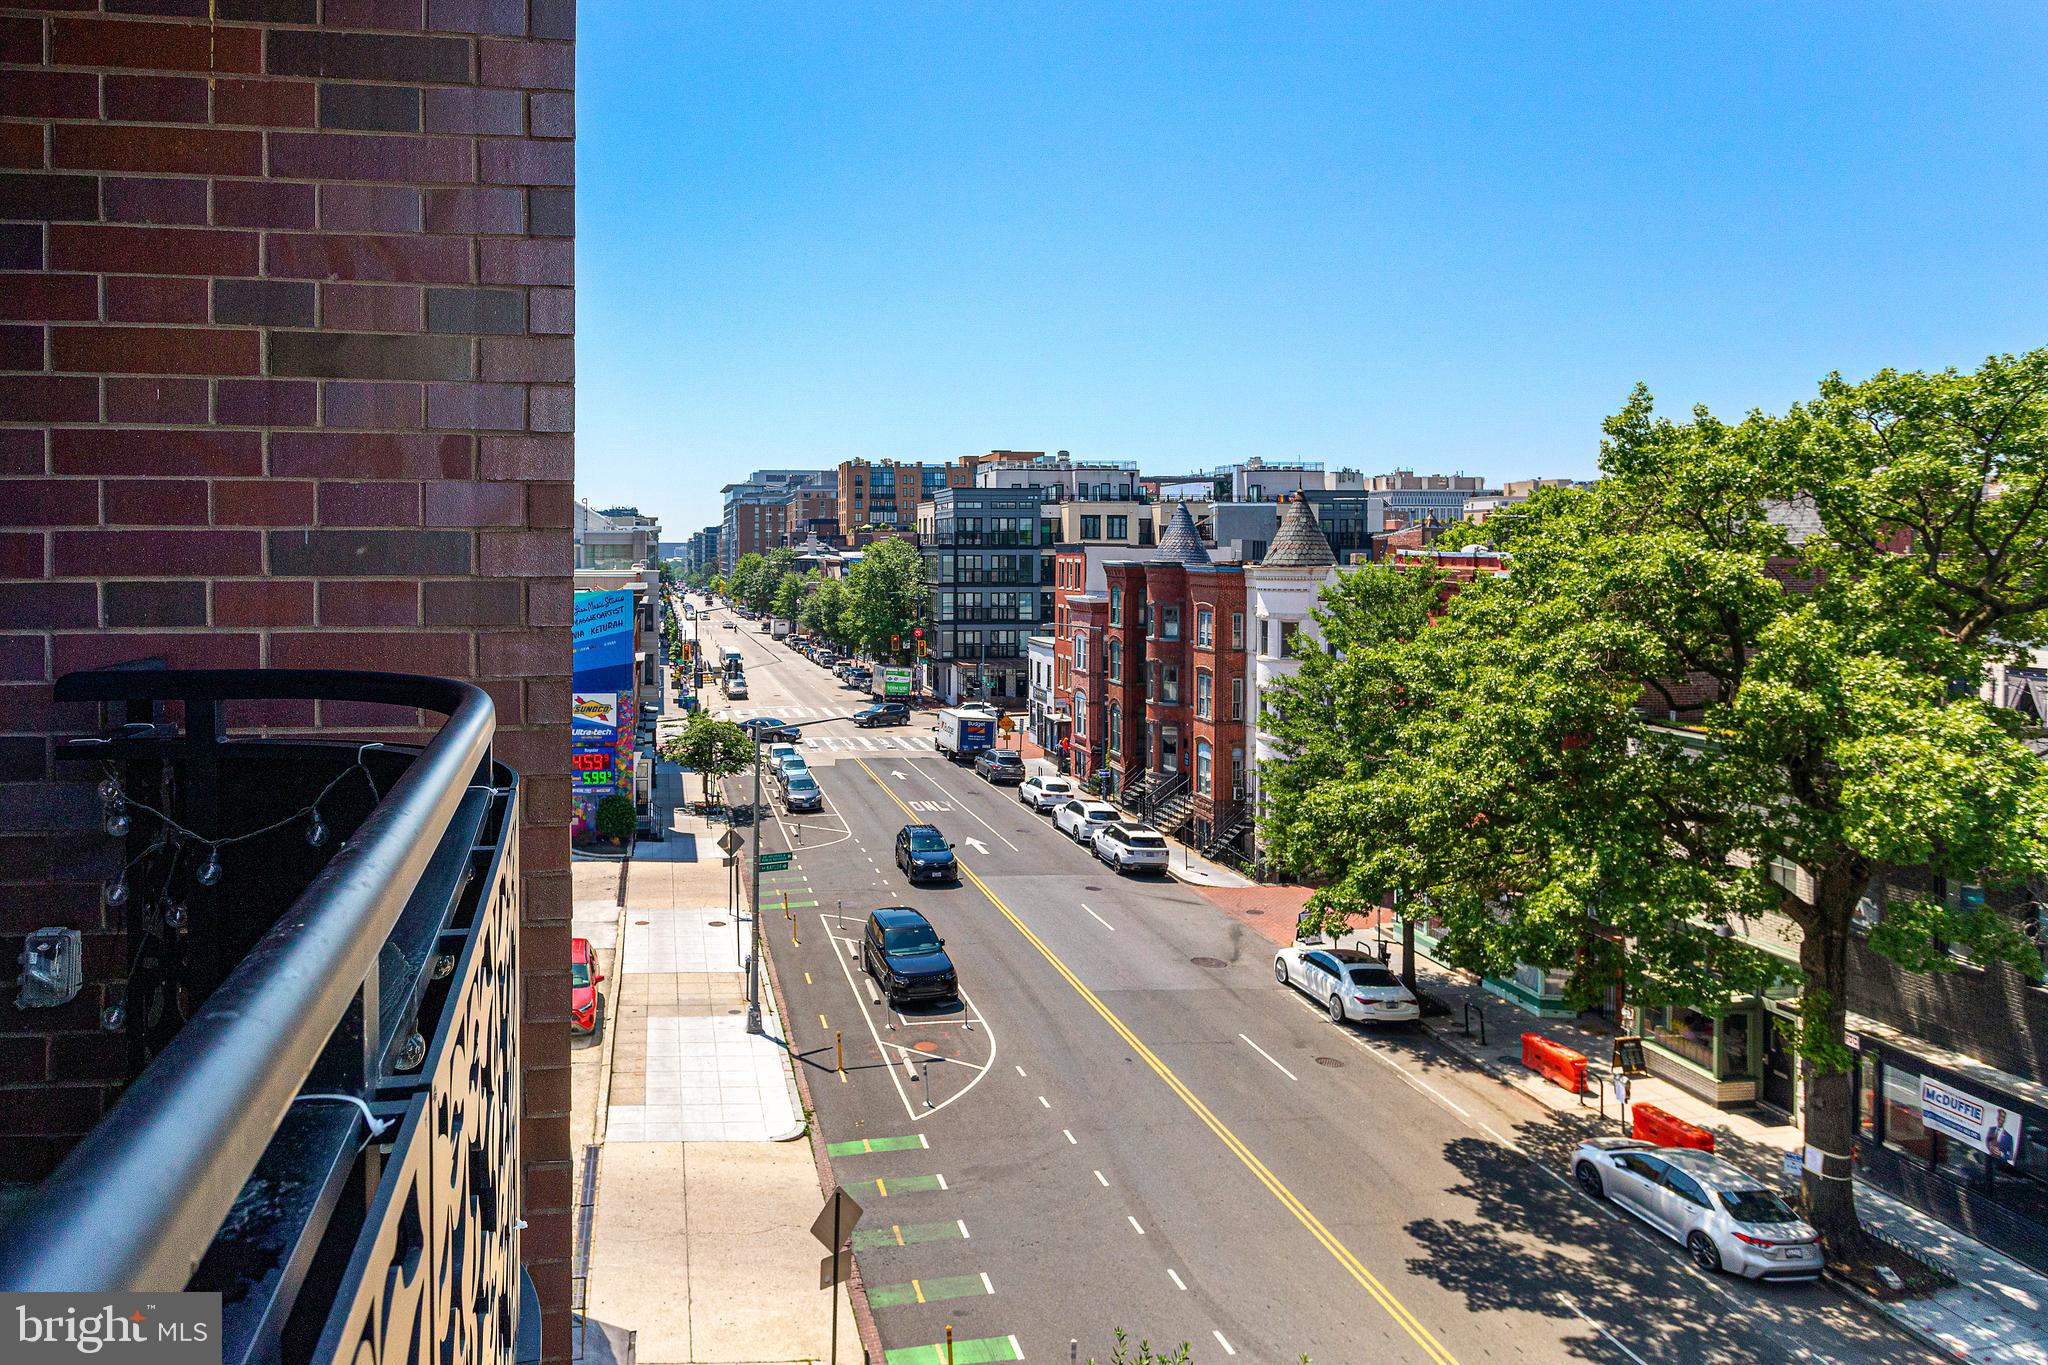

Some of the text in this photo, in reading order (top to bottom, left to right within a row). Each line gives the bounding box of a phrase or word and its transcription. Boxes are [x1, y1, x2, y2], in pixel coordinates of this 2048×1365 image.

[590, 620, 624, 635] KETURAH
[574, 705, 610, 713] SUNOCO
[908, 800, 957, 811] ONLY
[1925, 1087, 1982, 1120] McDUFFIE
